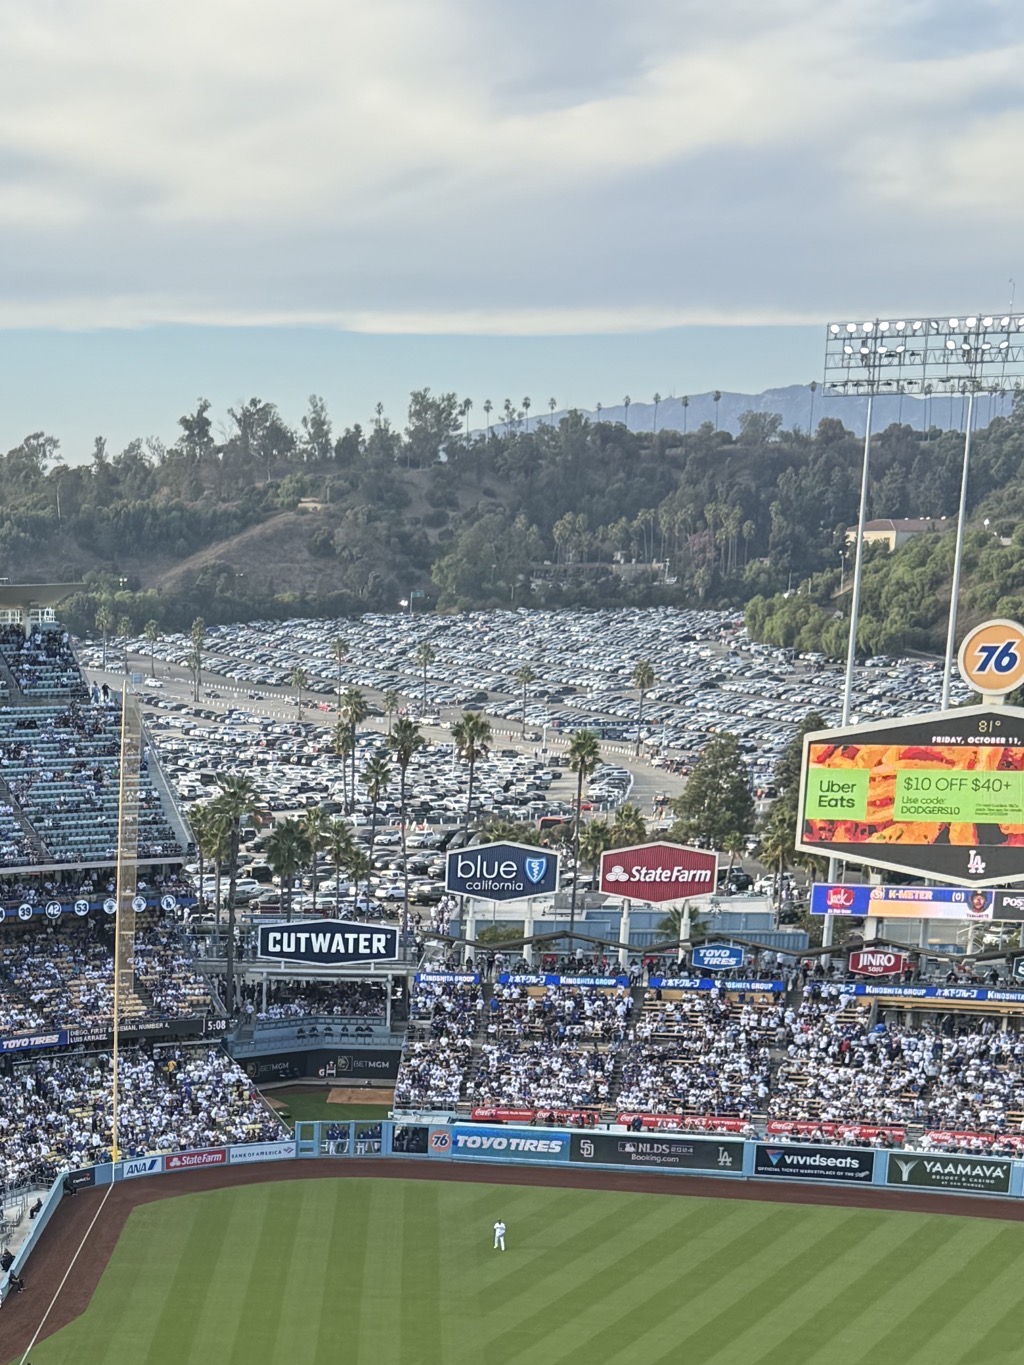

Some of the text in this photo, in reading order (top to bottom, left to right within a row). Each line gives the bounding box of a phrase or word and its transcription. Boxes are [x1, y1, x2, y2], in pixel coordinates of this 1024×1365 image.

[974, 640, 1018, 673] 76
[932, 736, 965, 745] FRIDAY,
[967, 736, 1006, 744] OCTOBER
[819, 780, 857, 793] Uber
[904, 776, 1012, 793] $10 OFF $40+
[817, 795, 856, 808] Eats
[902, 796, 947, 805] Use code:
[901, 806, 960, 815] DODGERS10
[457, 854, 517, 879] blue
[465, 880, 524, 891] california
[888, 889, 933, 900] K-METER
[20, 907, 31, 917] 39
[47, 904, 60, 915] 42
[76, 903, 87, 913] 53
[268, 931, 387, 954] CUTWATER
[698, 949, 730, 958] TOYO
[703, 957, 738, 966] TIRES
[857, 953, 895, 969] JINRO
[420, 974, 475, 983] KINOSHITA GROUP
[560, 976, 617, 986] KINOSHITA GROUP
[865, 985, 926, 996] KINOSHITA GROUP
[207, 1020, 226, 1031] 5:08
[3, 1034, 60, 1050] TOYO TIRES
[353, 1059, 390, 1069] BETMGM
[431, 1134, 450, 1147] 76
[456, 1135, 563, 1153] TOYO TIRES
[638, 1141, 670, 1154] NLDS
[255, 1150, 282, 1158] AMERICA
[631, 1153, 679, 1164] Booking.com
[126, 1162, 147, 1175] ANA
